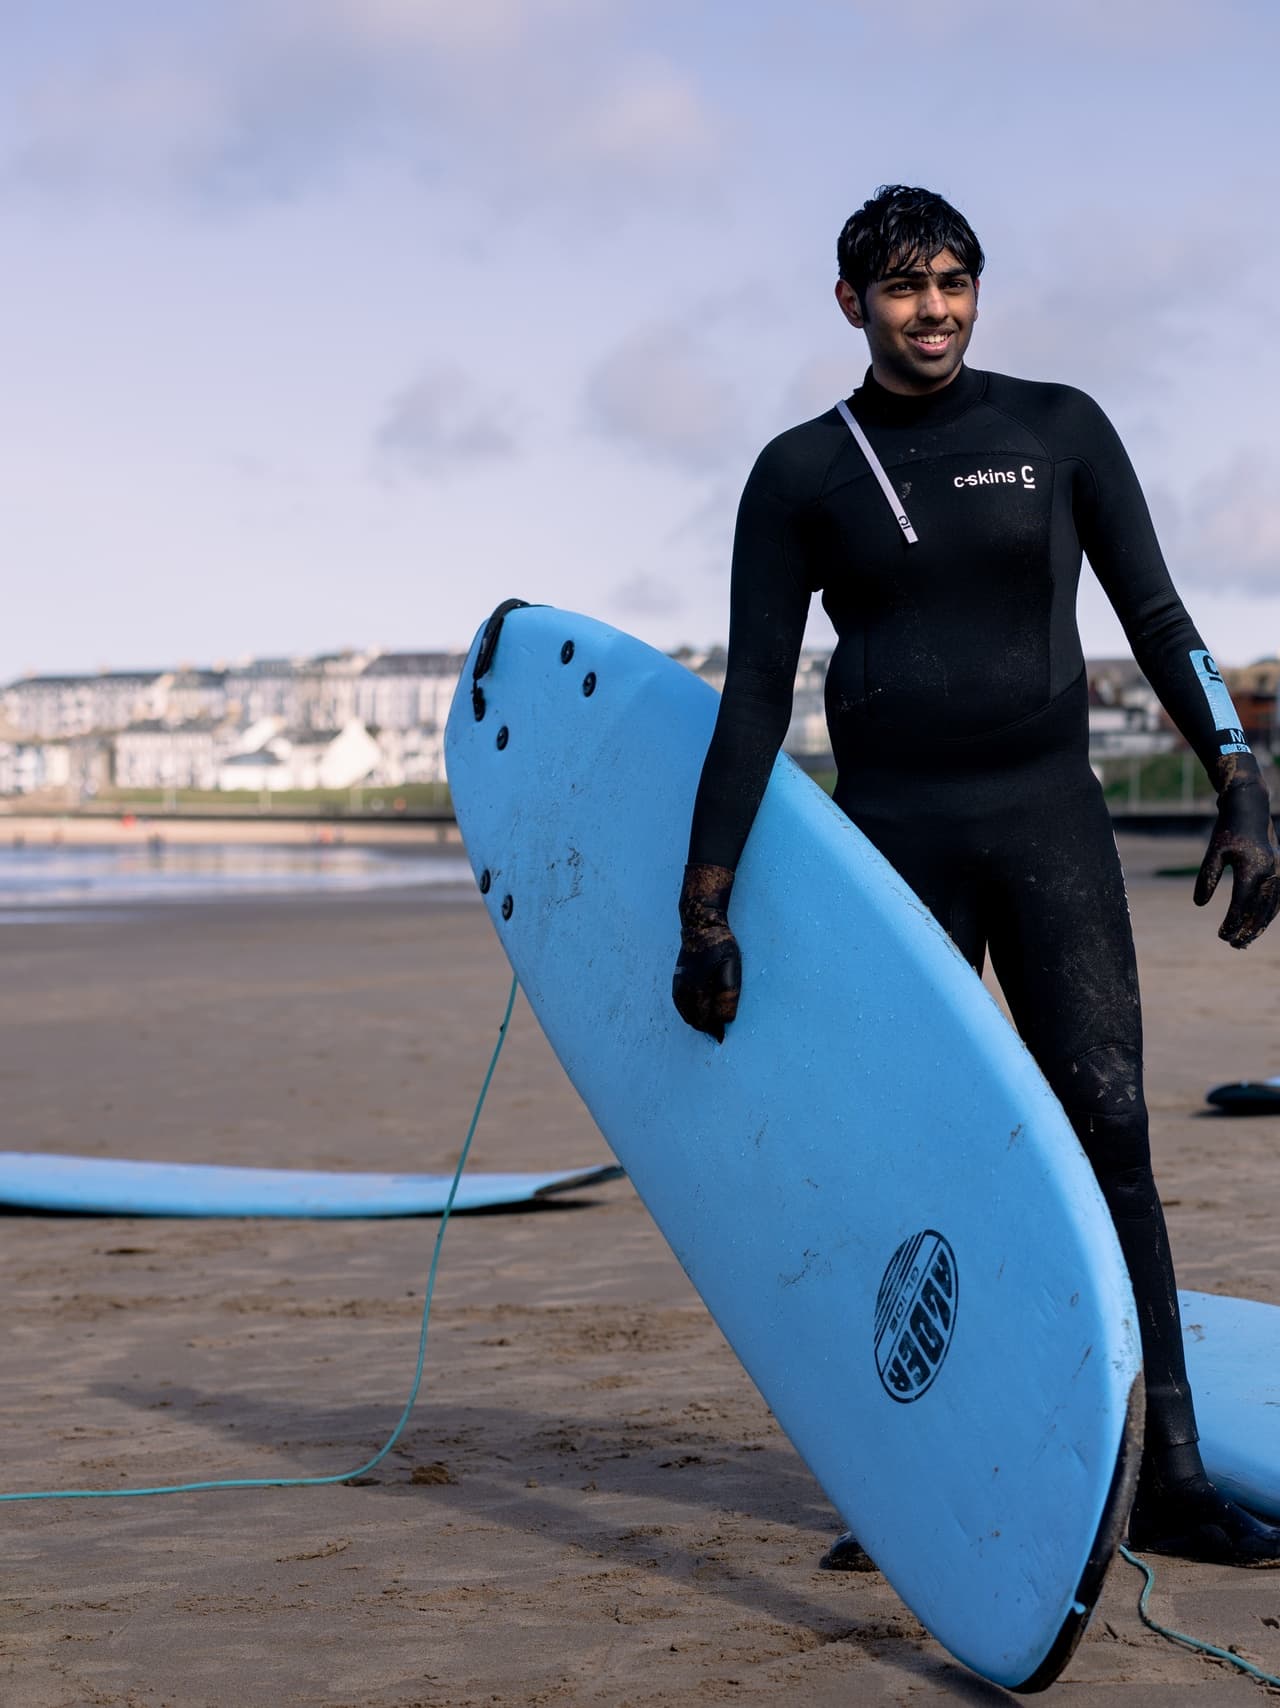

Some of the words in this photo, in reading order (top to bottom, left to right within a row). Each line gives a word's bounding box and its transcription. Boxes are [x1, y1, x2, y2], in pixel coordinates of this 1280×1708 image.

[954, 469, 1017, 488] c-skins
[888, 1248, 953, 1393] ALDER
[889, 1265, 920, 1335] GLIDE
